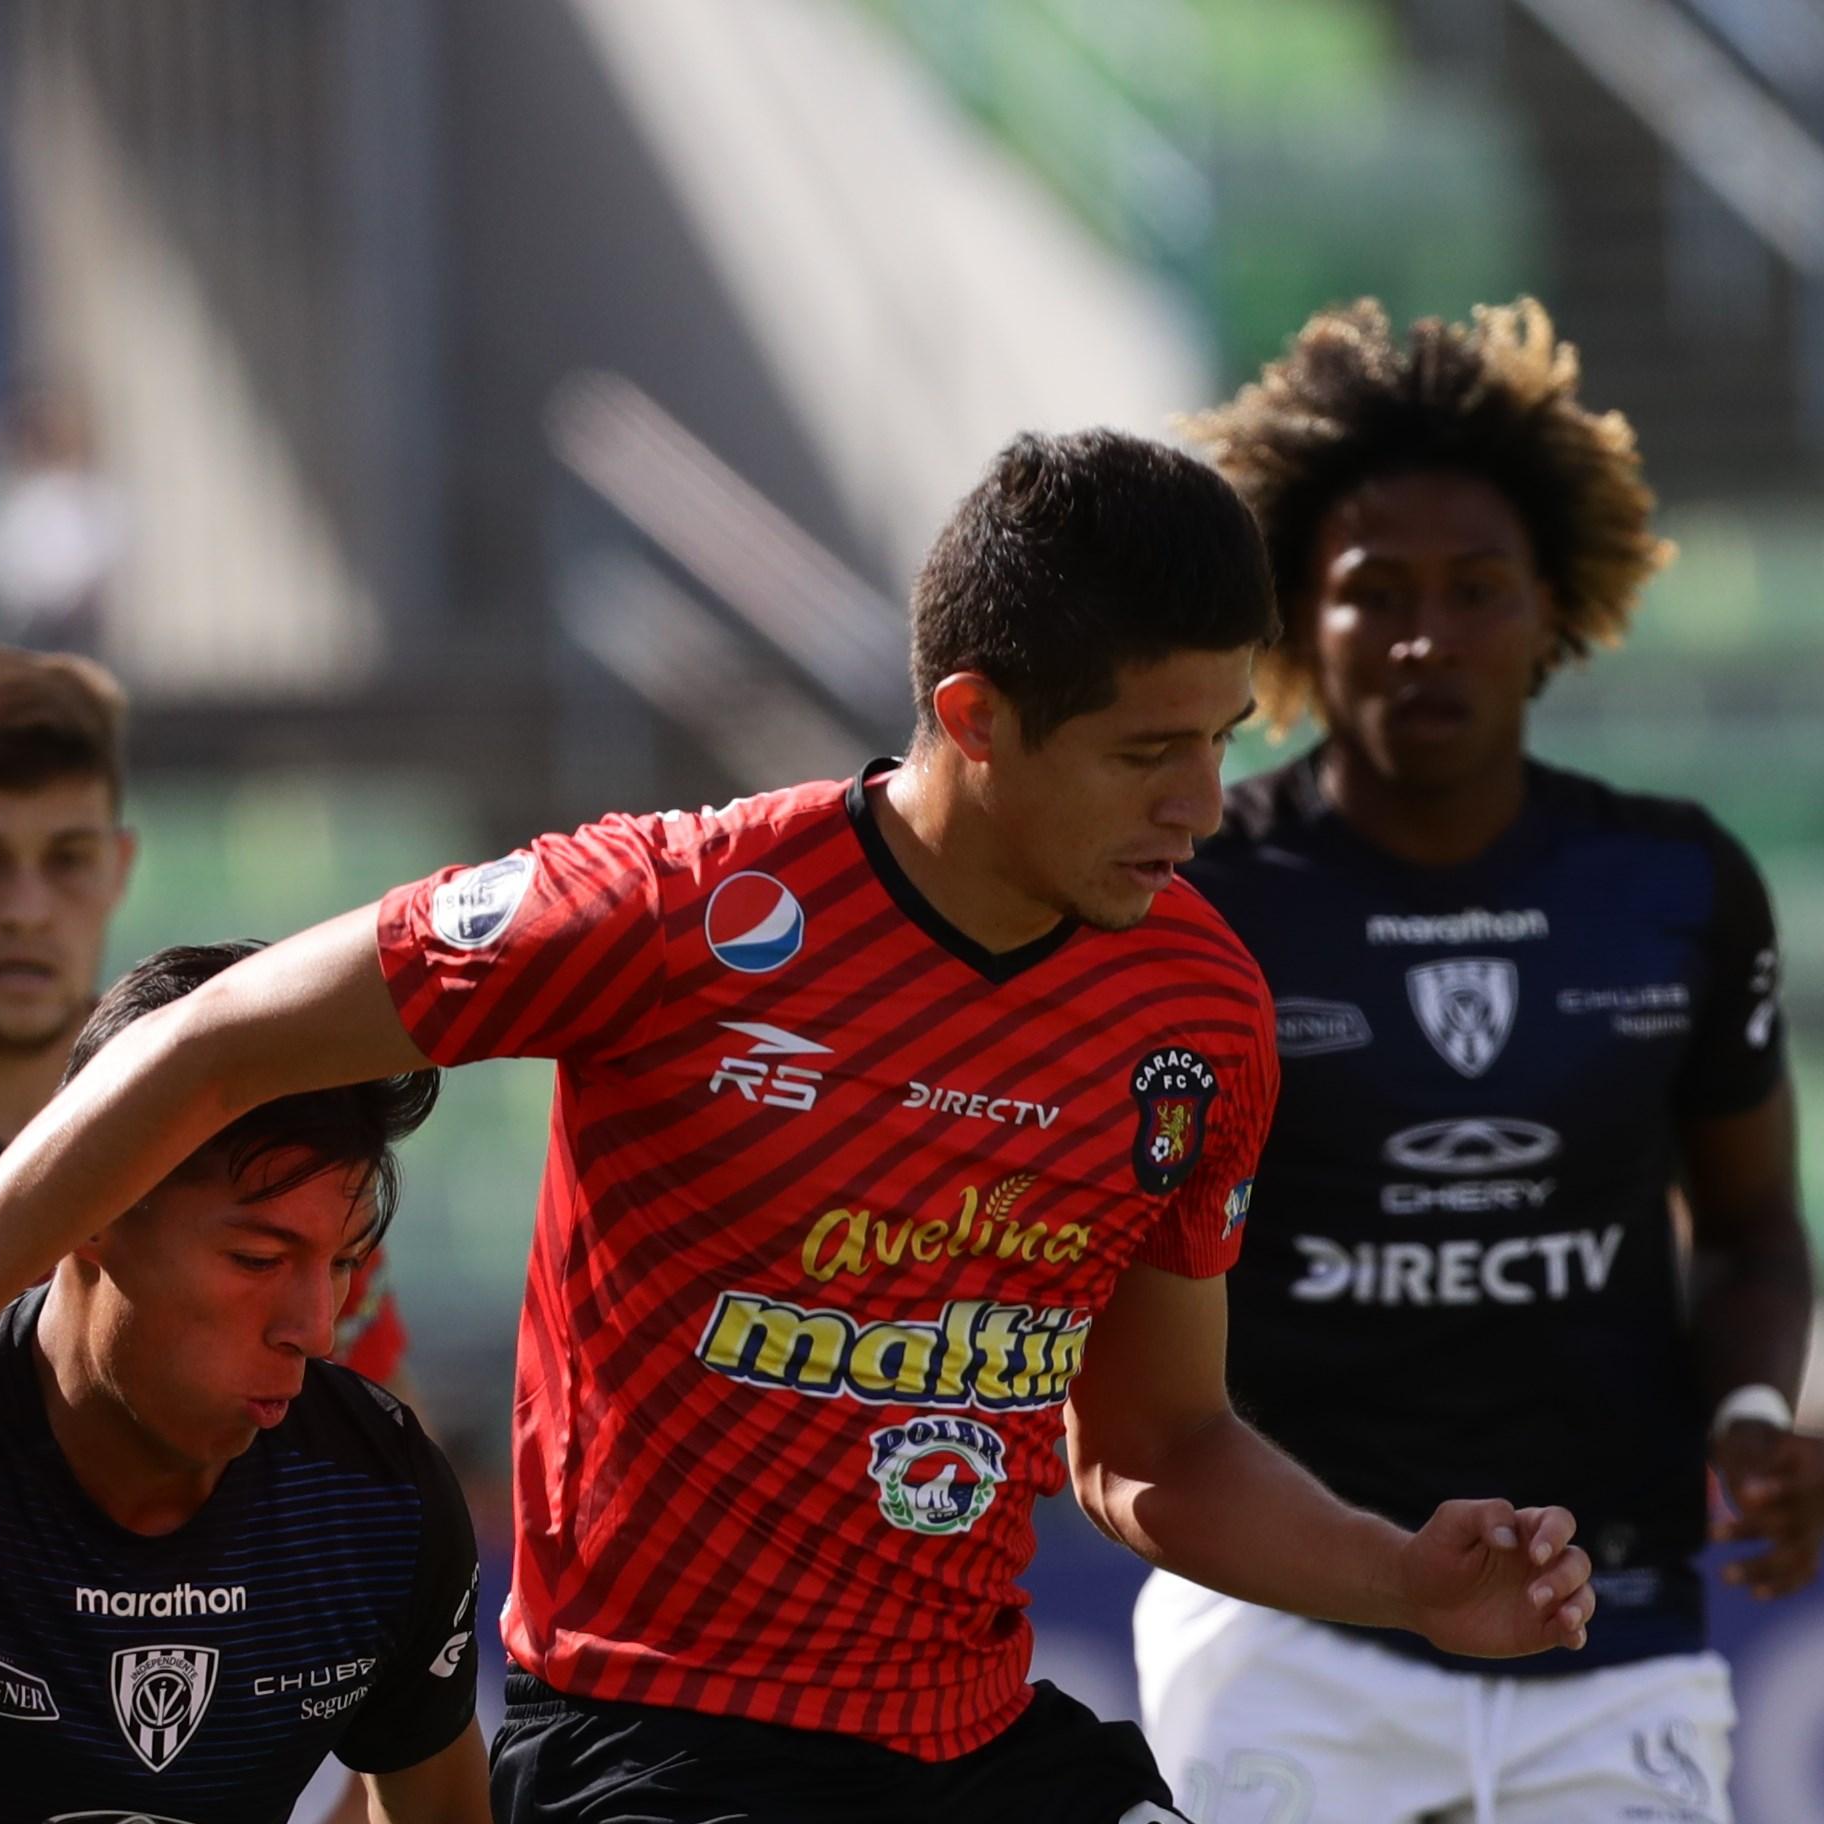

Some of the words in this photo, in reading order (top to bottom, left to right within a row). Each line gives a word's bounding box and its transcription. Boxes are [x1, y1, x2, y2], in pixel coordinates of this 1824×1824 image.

[709, 1057, 823, 1111] RS
[1136, 1051, 1213, 1091] CARACAS
[1164, 1075, 1187, 1089] FC
[902, 1082, 1060, 1129] DIRECTV
[1290, 1223, 1624, 1305] DIRECTV
[873, 1420, 1004, 1478] POLAR
[76, 1583, 247, 1617] marathon
[131, 1656, 198, 1682] INDEPENDIENTE
